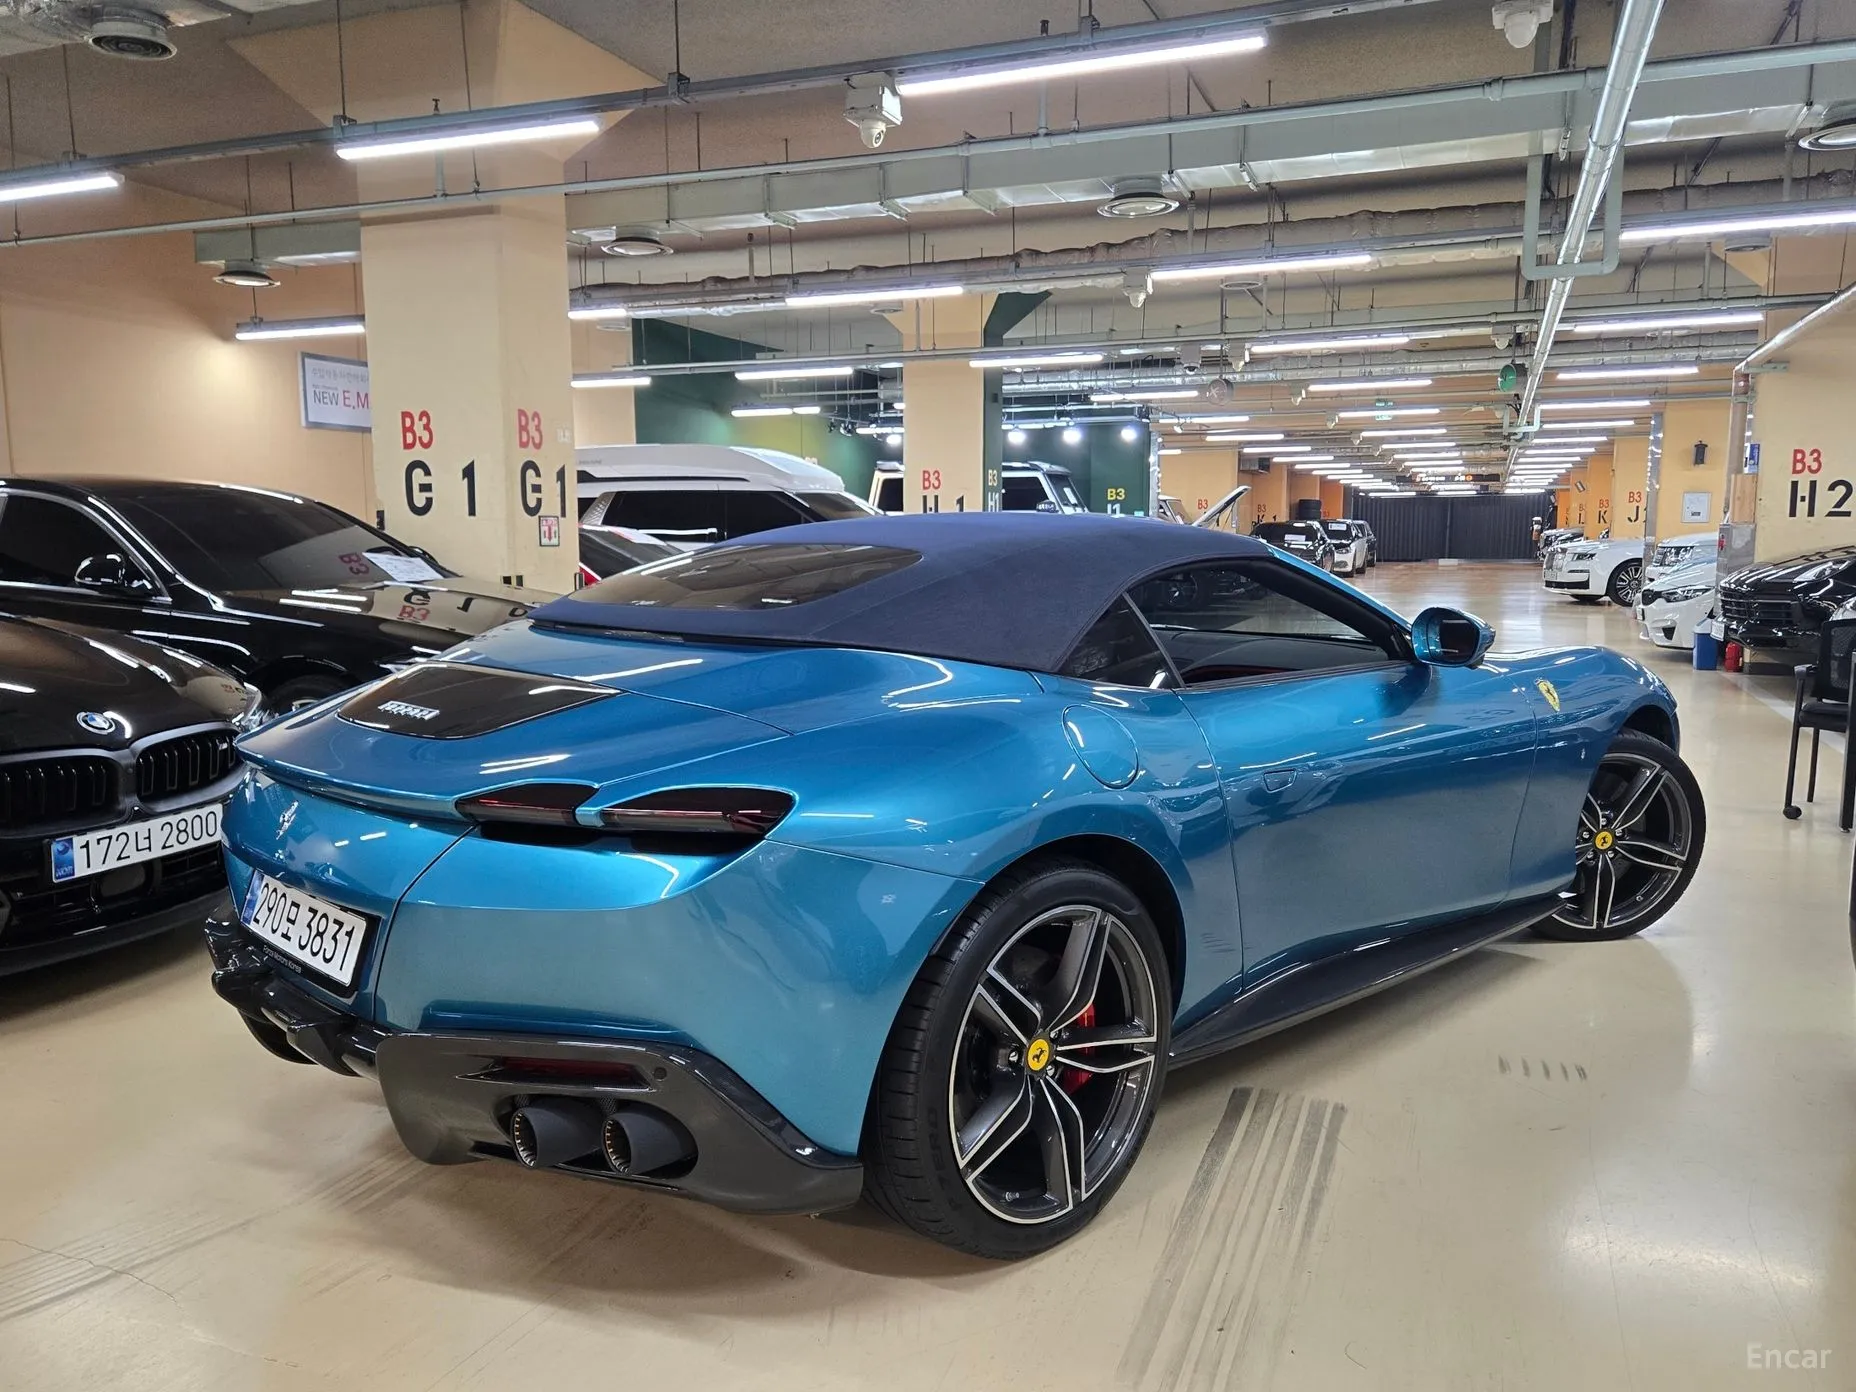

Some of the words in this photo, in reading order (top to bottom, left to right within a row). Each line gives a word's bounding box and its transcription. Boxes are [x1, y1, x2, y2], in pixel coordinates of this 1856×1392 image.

[313, 389, 339, 406] NEW
[401, 410, 434, 450] B3
[517, 408, 543, 450] B3
[1791, 448, 1822, 475] B3
[922, 470, 942, 490] B3
[987, 469, 998, 487] B3
[1107, 487, 1126, 501] B3
[1628, 491, 1642, 504] B3
[1197, 498, 1209, 510] B3
[1257, 503, 1267, 513] B3
[1599, 499, 1610, 509] B3
[1597, 510, 1608, 524] K
[79, 827, 153, 869] 172너
[160, 810, 219, 850] 2800
[252, 882, 301, 943] 290모
[298, 906, 356, 972] 3831
